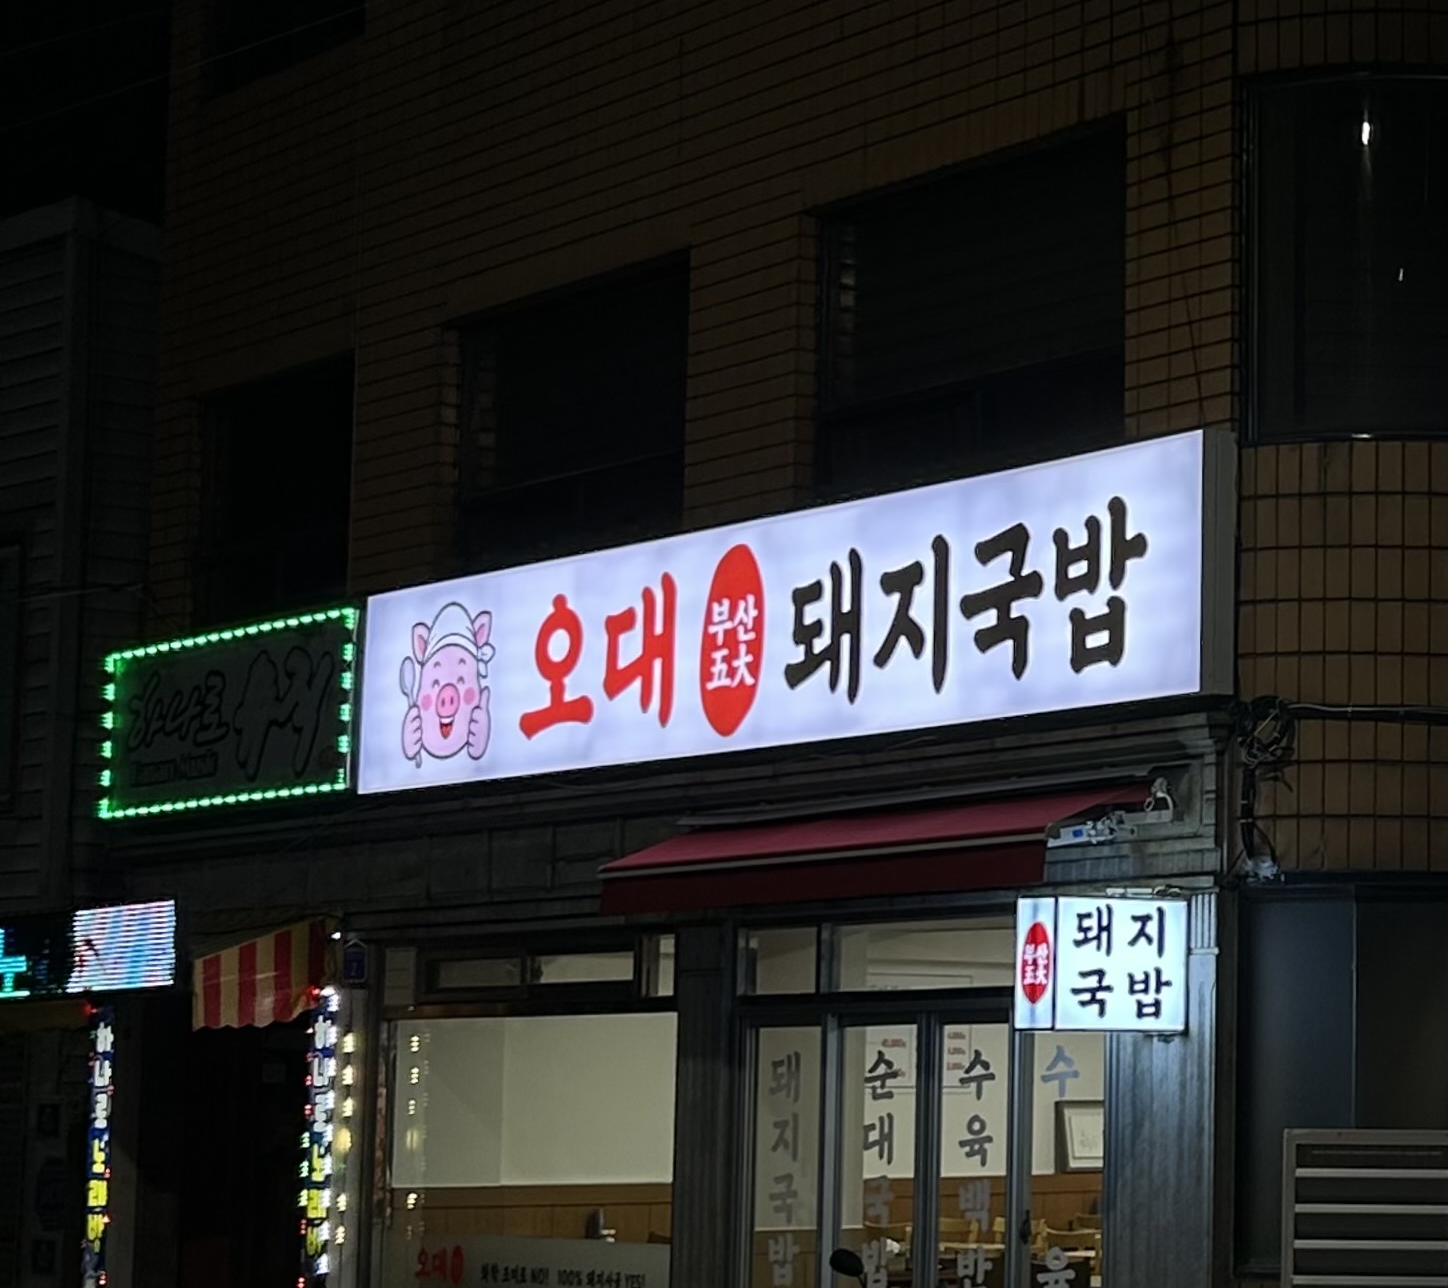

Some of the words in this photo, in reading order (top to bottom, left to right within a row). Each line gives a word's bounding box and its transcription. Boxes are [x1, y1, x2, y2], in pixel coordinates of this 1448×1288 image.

[708, 594, 758, 645] 부산
[786, 495, 1148, 705] 돼지국밥
[518, 571, 678, 740] 오대
[706, 644, 757, 689] 五大
[1072, 903, 1166, 959] 돼지
[1070, 966, 1173, 1019] 국밥
[767, 1051, 801, 1287] 돼지국밥
